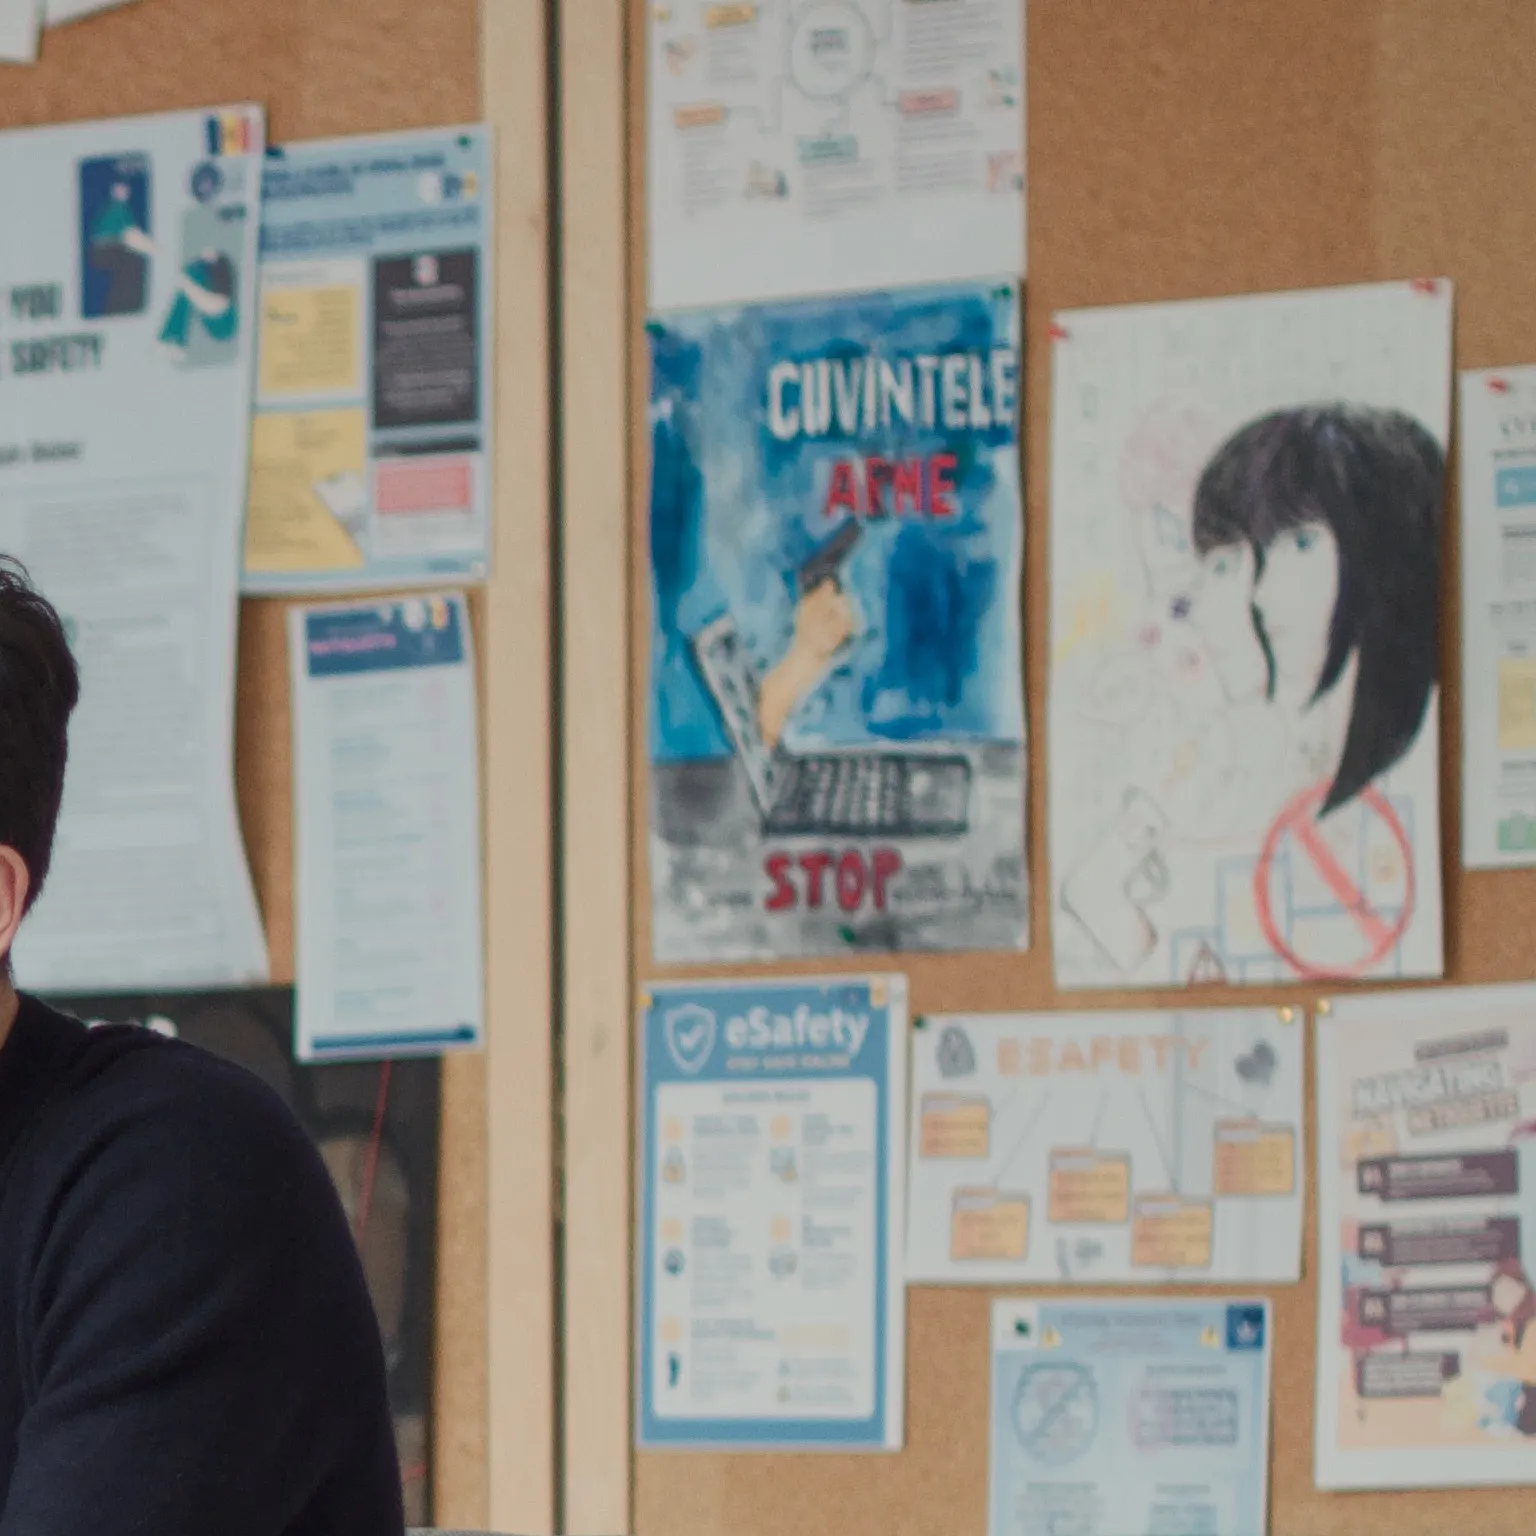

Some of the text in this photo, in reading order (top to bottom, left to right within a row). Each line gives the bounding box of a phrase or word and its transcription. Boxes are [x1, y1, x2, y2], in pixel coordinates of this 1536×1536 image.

[10, 283, 62, 319] YOU
[10, 332, 104, 373] SAFETY
[768, 349, 1019, 441] CUVINTELE
[764, 847, 904, 911] STOP
[725, 1002, 870, 1058] eSafety
[996, 1034, 1211, 1077] ESAFETY
